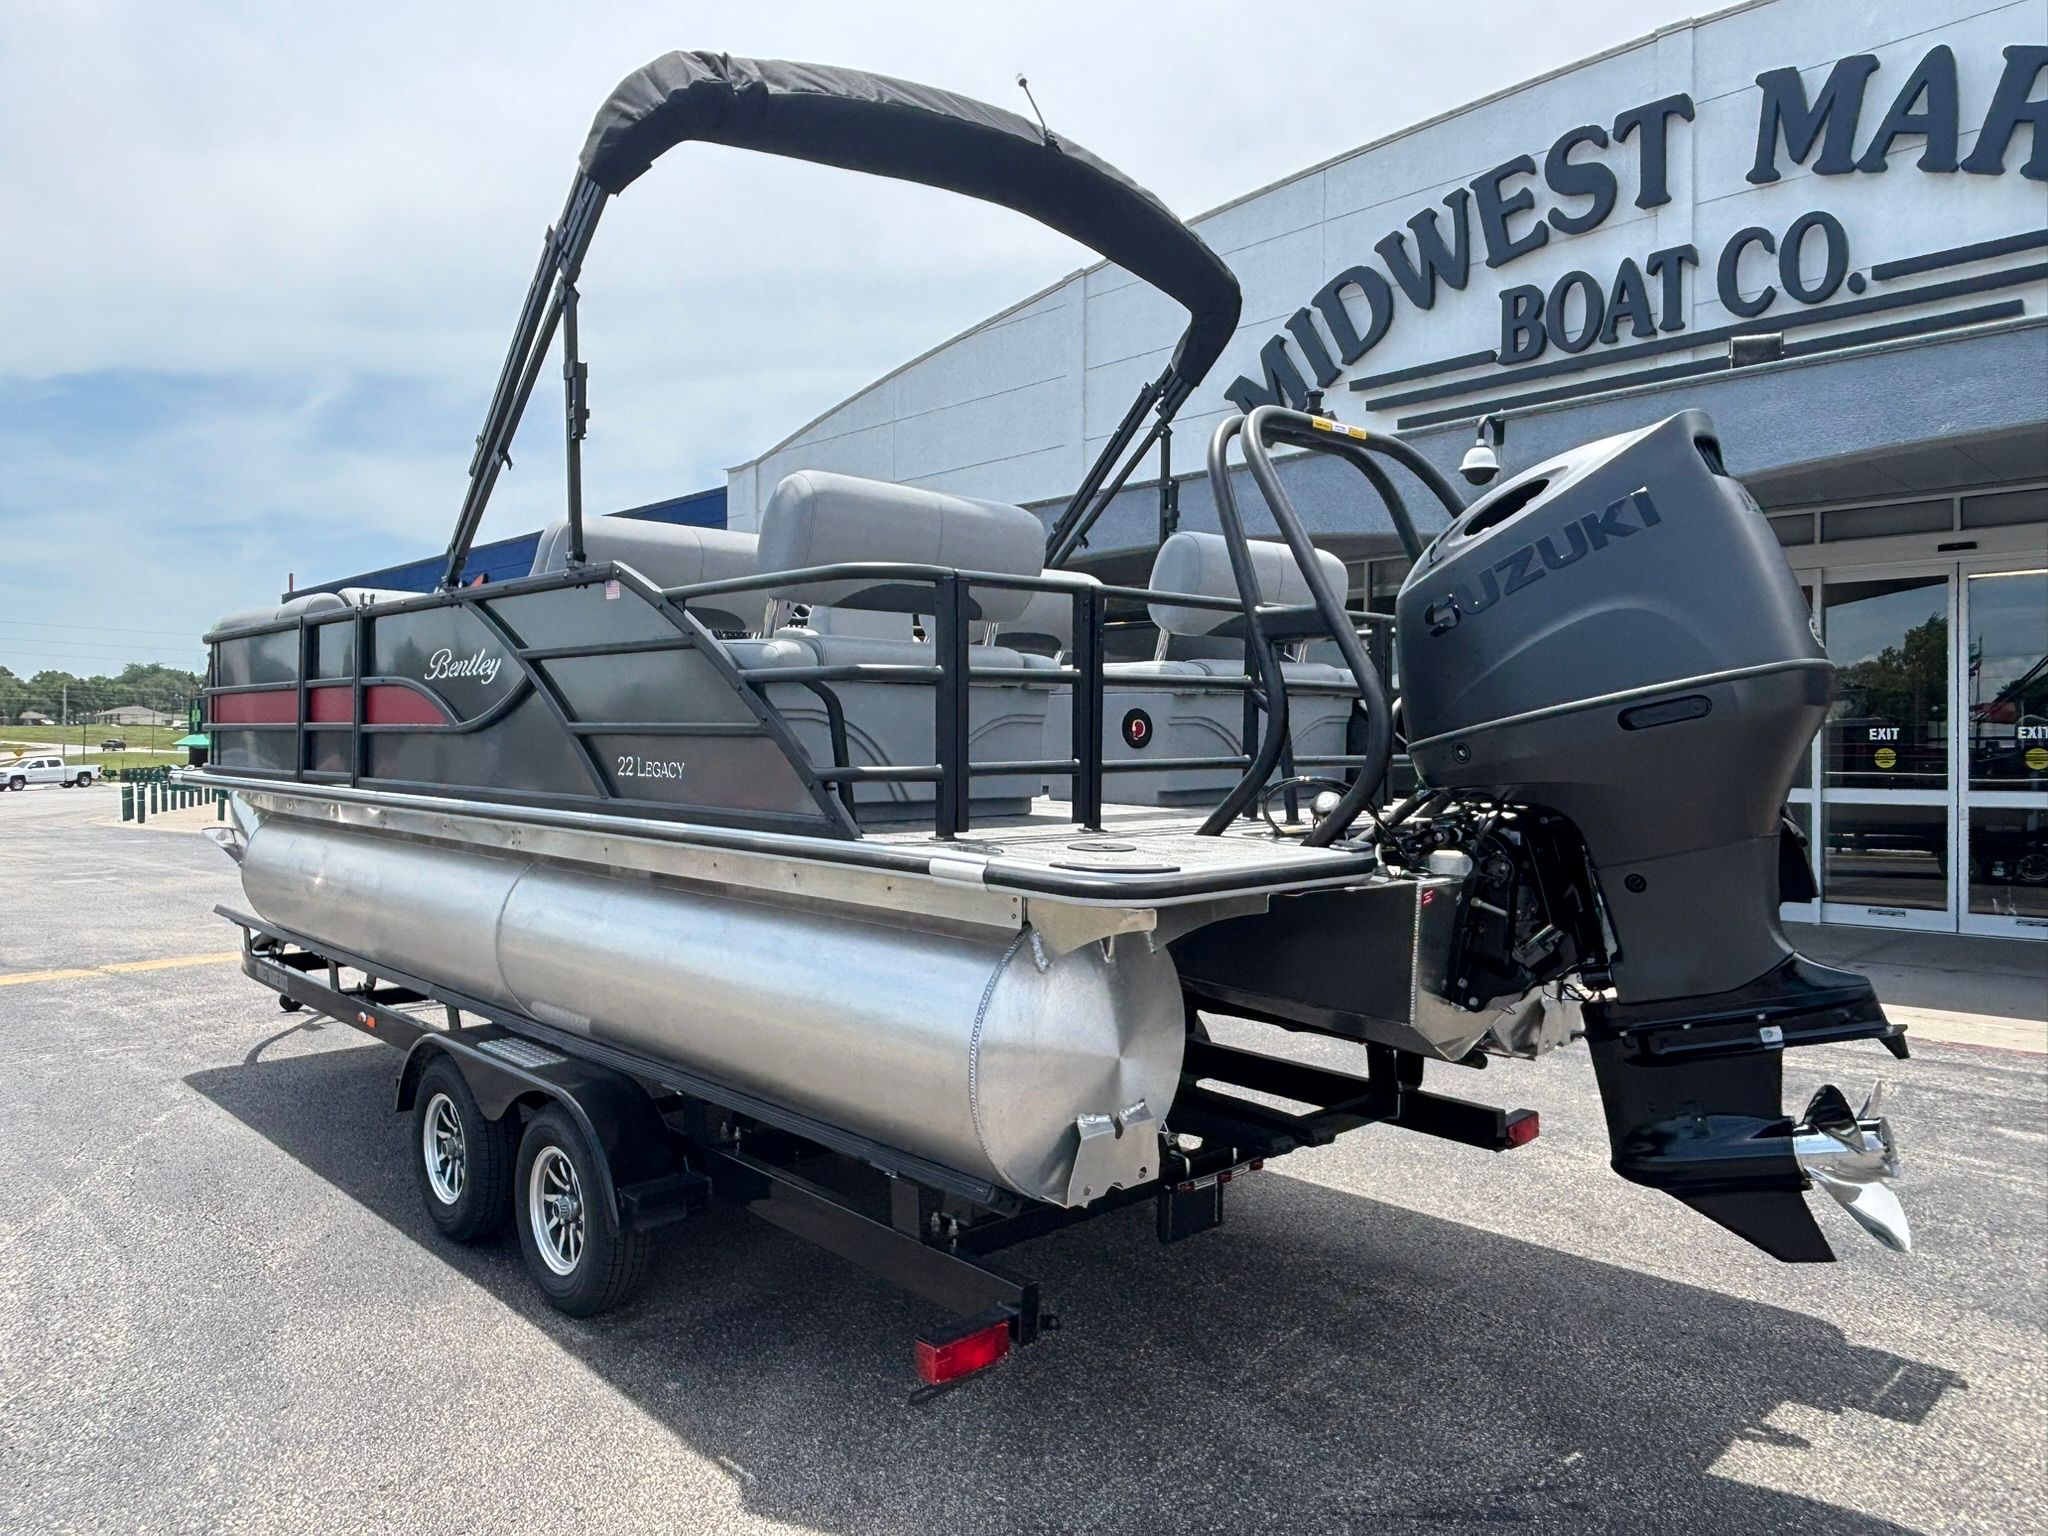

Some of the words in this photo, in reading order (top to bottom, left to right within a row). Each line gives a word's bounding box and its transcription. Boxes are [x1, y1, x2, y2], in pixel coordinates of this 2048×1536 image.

[1224, 92, 1695, 415] MIDWEST
[1498, 243, 1699, 365] BOAT
[1717, 210, 1867, 318] CO.
[1425, 485, 1661, 638] SUZUKI
[424, 648, 502, 685] Bentley
[617, 755, 634, 777] 22
[1869, 727, 1900, 741] EXIT
